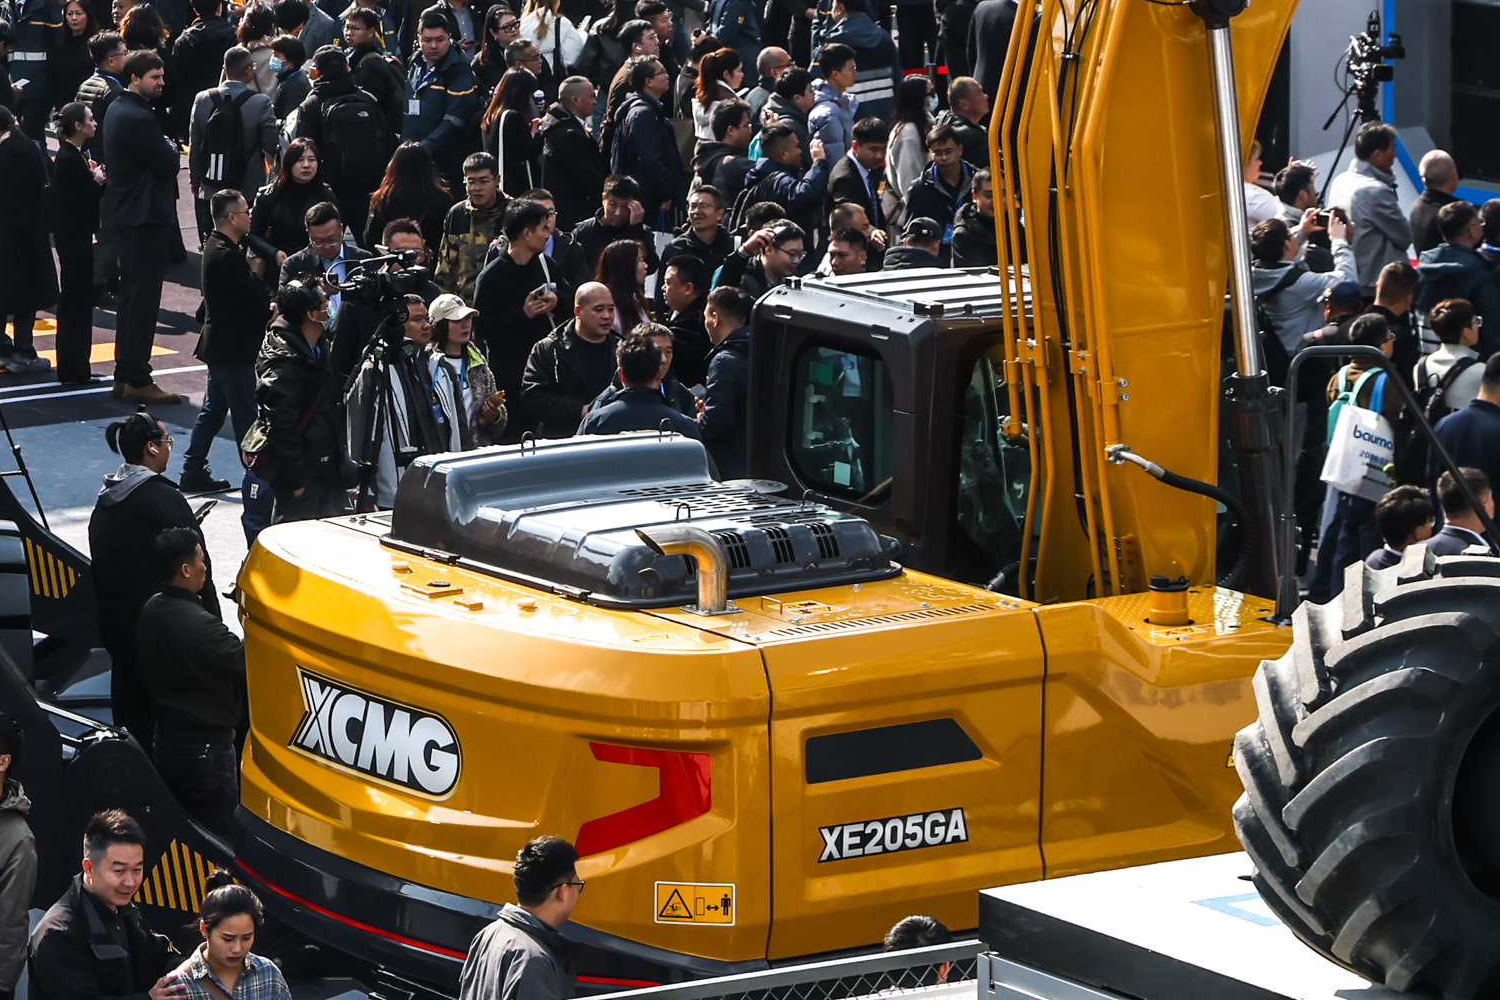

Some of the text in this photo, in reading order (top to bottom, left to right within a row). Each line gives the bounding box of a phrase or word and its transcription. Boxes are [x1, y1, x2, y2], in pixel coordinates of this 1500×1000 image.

[1353, 424, 1394, 451] bauma
[292, 671, 460, 795] XCMG
[820, 811, 967, 863] XE205GA
